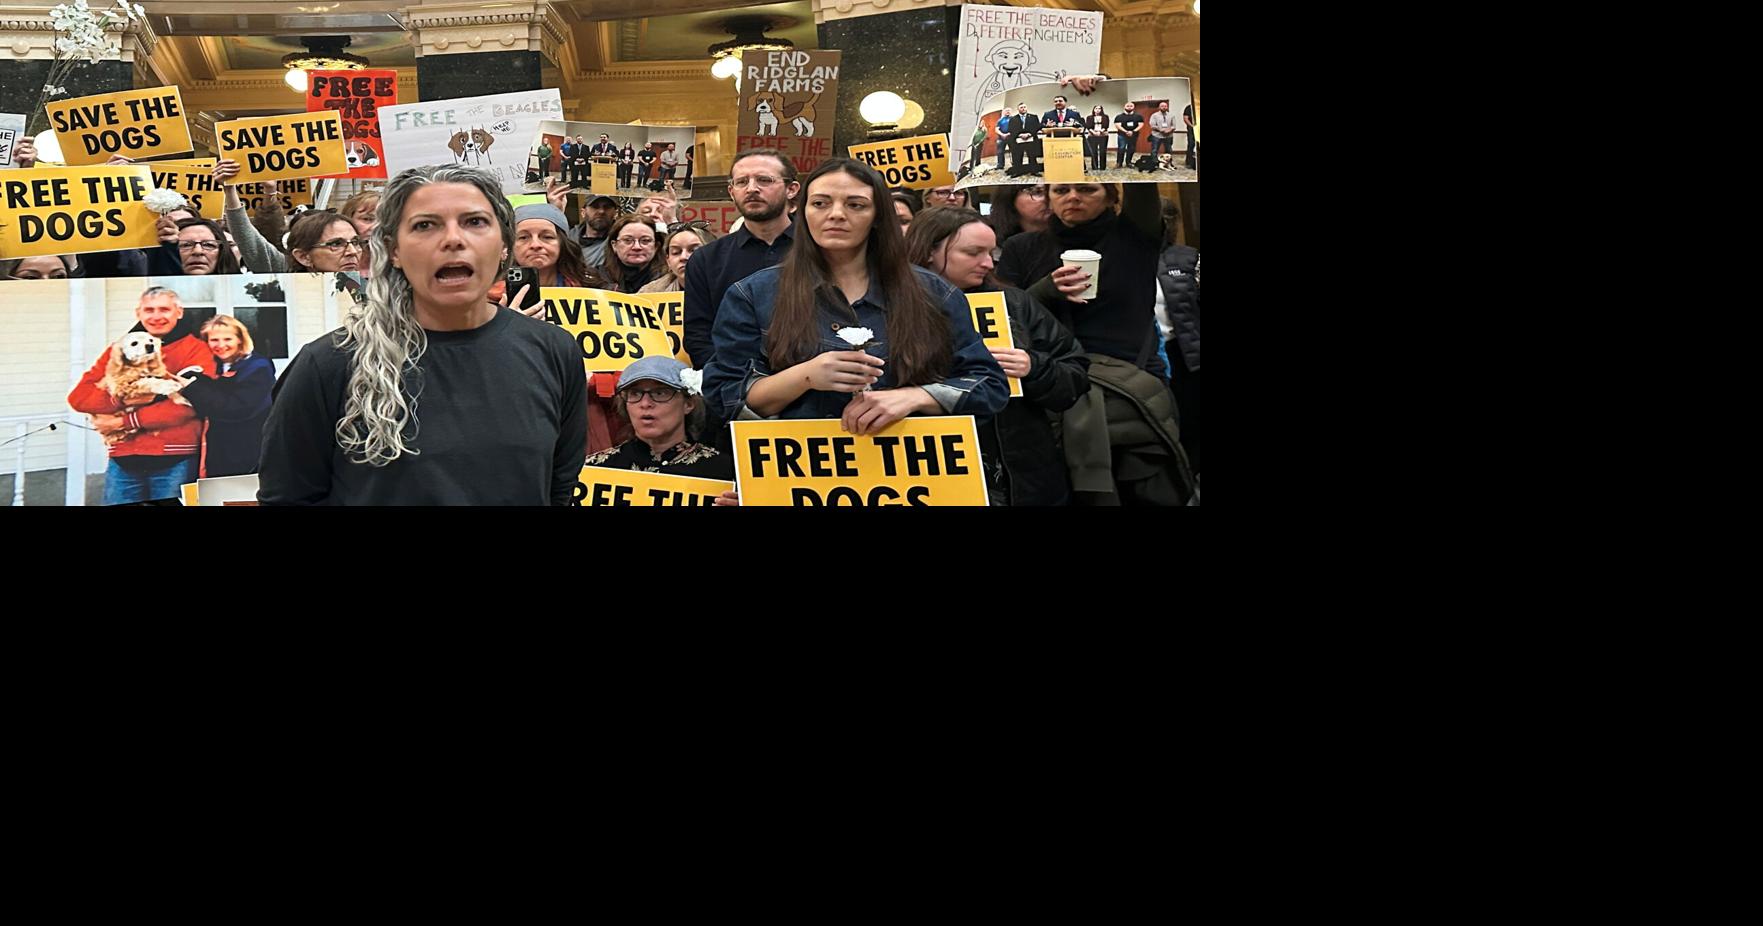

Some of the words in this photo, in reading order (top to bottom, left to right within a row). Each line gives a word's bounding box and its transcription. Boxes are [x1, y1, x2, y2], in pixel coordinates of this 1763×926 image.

[967, 9, 1003, 23] FREE
[1005, 11, 1033, 26] THE
[1039, 13, 1096, 30] BEAGLES
[748, 65, 839, 80] RIDGLAN
[768, 51, 810, 67] END
[312, 76, 394, 98] FREE
[755, 78, 825, 94] FARMS
[52, 102, 120, 133] SAVE
[124, 95, 180, 122] THE
[324, 97, 376, 119] THE
[394, 109, 456, 131] FREE
[492, 98, 561, 118] BEAGLES
[81, 124, 162, 156] DOGS
[221, 124, 285, 151] SAVE
[291, 119, 340, 143] THE
[798, 138, 830, 156] THE
[247, 146, 321, 174] DOGS
[855, 147, 898, 167] FREE
[903, 141, 945, 162] THE
[0, 178, 72, 209] REE
[81, 176, 146, 204] THE
[18, 208, 126, 244] DOGS
[608, 300, 661, 331] THE
[748, 437, 859, 478] FREE
[872, 434, 969, 476] THE
